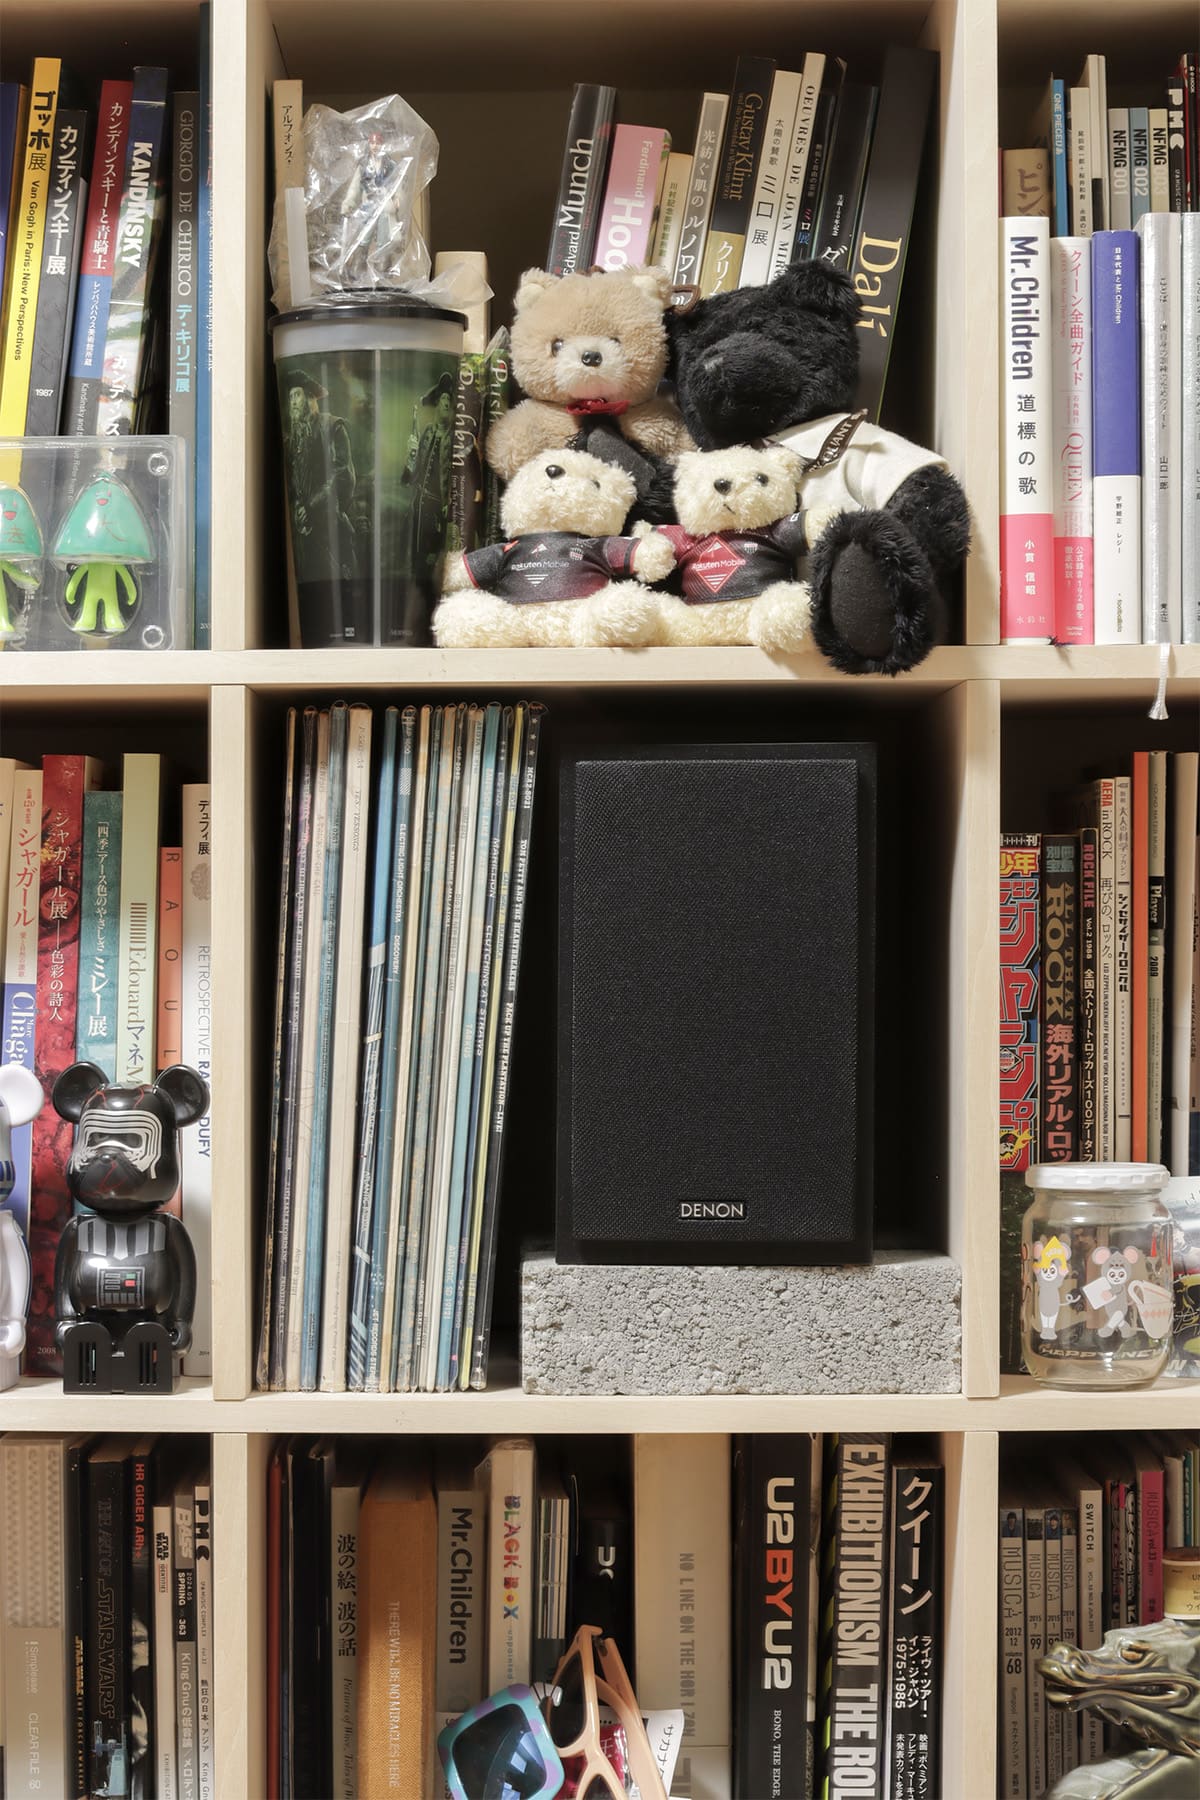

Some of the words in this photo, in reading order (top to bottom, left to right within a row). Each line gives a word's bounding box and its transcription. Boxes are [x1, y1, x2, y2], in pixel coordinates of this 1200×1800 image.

[27, 90, 57, 172] ゴッホ展
[738, 92, 764, 154] Gustav
[794, 85, 816, 155] OEUVRES
[179, 110, 195, 182] GIORGIO
[1112, 129, 1128, 195] NFMG001
[1132, 128, 1149, 196] NFMG002
[29, 180, 41, 199] Van
[93, 102, 124, 270] カンディンスキーと青騎士
[558, 138, 594, 230] Munch
[728, 150, 756, 201] Klimt
[789, 163, 802, 185] DE
[26, 200, 38, 228] Gogh
[46, 126, 78, 276] カンディンスキー展
[121, 142, 153, 268] KANDINSKY
[179, 191, 193, 213] DE
[751, 174, 778, 246] ミロ展
[781, 193, 798, 232] JOAN
[27, 231, 33, 239] in
[797, 208, 812, 245] ミロ展
[177, 219, 193, 296] CHIRICO
[562, 231, 580, 276] Edvard
[21, 272, 32, 295] New
[14, 297, 29, 361] Perspectives
[1069, 250, 1084, 386] クイーン全曲ガイド
[35, 388, 54, 398] 1987
[1017, 394, 1037, 495] 道標の歌
[1061, 431, 1084, 502] QUEEN
[511, 560, 543, 571] Rakuten
[543, 559, 570, 569] Mobile
[692, 559, 720, 572] Rakuten
[720, 557, 747, 568] Mobile
[1101, 781, 1113, 807] AERA
[1101, 809, 1113, 820] in
[399, 824, 407, 856] ELECTRIC
[519, 839, 528, 855] TOM
[1102, 822, 1113, 860] ROCK
[13, 828, 39, 928] シャガール
[397, 857, 405, 880] LIGHT
[489, 837, 500, 898] MARILLION
[516, 857, 526, 883] PETTY
[1083, 844, 1096, 879] ROCK
[394, 881, 404, 923] ORCHESTRA
[513, 903, 522, 919] THE
[515, 885, 524, 902] AND
[1083, 882, 1096, 908] FILE
[1150, 885, 1163, 924] Player
[1101, 877, 1114, 960] 再びの、ロック。
[392, 935, 400, 974] DISCOVERY
[480, 925, 492, 987] CLUTCHING
[506, 921, 521, 992] HEARTBREAKERS
[1045, 882, 1065, 1021] ROCK
[1150, 956, 1159, 977] 2009
[88, 956, 110, 1038] ミレー展
[127, 947, 147, 1028] Edouard
[198, 945, 211, 1056] RETROSPECTIVE
[480, 989, 488, 1004] AT
[476, 1007, 486, 1056] STRAWS
[503, 1024, 512, 1035] UP
[505, 1002, 514, 1023] PACK
[127, 1025, 146, 1065] マネ
[502, 1036, 511, 1053] THE
[681, 1203, 743, 1218] DENON
[135, 1463, 145, 1481] HR
[135, 1484, 145, 1523] GIGER
[766, 1477, 795, 1545] U2
[175, 1507, 193, 1559] BASS
[503, 1495, 522, 1569] BLACK
[899, 1476, 933, 1616] クイーン
[1085, 1503, 1094, 1551] SWITCH
[679, 1553, 695, 1571] NO
[837, 1444, 885, 1666] EXHIBITIONISM
[1063, 1548, 1075, 1590] MUSICA
[178, 1572, 186, 1606] SPRING
[337, 1533, 357, 1657] 波の絵、波の話
[450, 1508, 473, 1664] Mr.Children
[679, 1577, 695, 1611] LINE
[765, 1549, 794, 1618] BY
[1002, 1546, 1022, 1619] MUSICA
[1029, 1553, 1041, 1600] MUSICA
[1047, 1553, 1059, 1602] MUSICA
[98, 1578, 116, 1648] STAR
[503, 1577, 521, 1620] BOX
[178, 1618, 187, 1636] 363
[679, 1615, 695, 1634] ON
[1005, 1628, 1022, 1637] 2012
[1030, 1638, 1042, 1650] 99
[1064, 1631, 1075, 1640] 139
[679, 1639, 696, 1666] THE
[764, 1620, 793, 1690] U2
[895, 1637, 907, 1709] 1975-1985
[908, 1635, 919, 1709] イン・ジャパン
[1006, 1658, 1022, 1674] 68
[99, 1648, 116, 1719] WARS
[388, 1682, 401, 1698] NO
[28, 1712, 40, 1750] CLEAR
[388, 1699, 401, 1758] MIRACLES
[772, 1709, 782, 1742] BONO,
[834, 1683, 879, 1741] THE
[29, 1751, 40, 1775] FILE
[389, 1758, 401, 1788] HERE
[773, 1744, 782, 1765] THE
[771, 1768, 781, 1800] EDGE,
